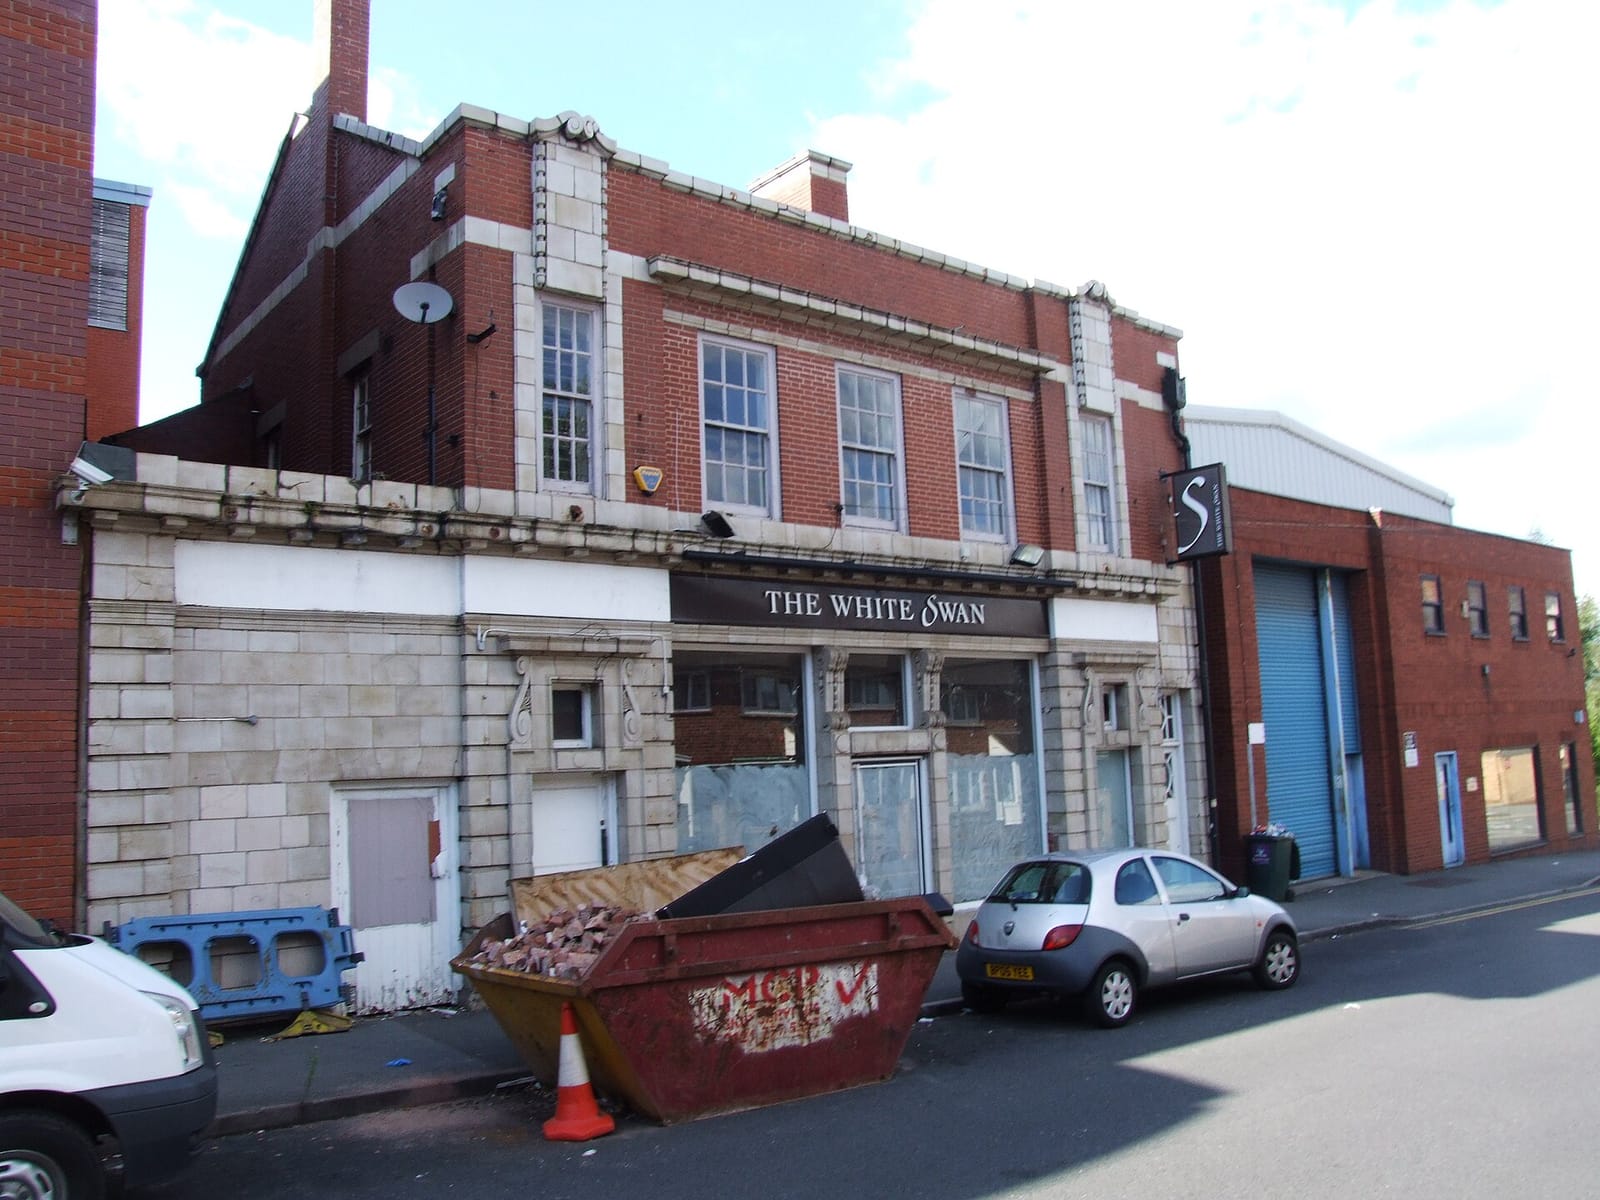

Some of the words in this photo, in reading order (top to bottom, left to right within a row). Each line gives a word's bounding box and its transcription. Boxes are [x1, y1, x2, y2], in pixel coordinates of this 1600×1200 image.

[765, 590, 822, 616] THE
[829, 594, 914, 620] WHITE
[921, 594, 985, 627] SWAN
